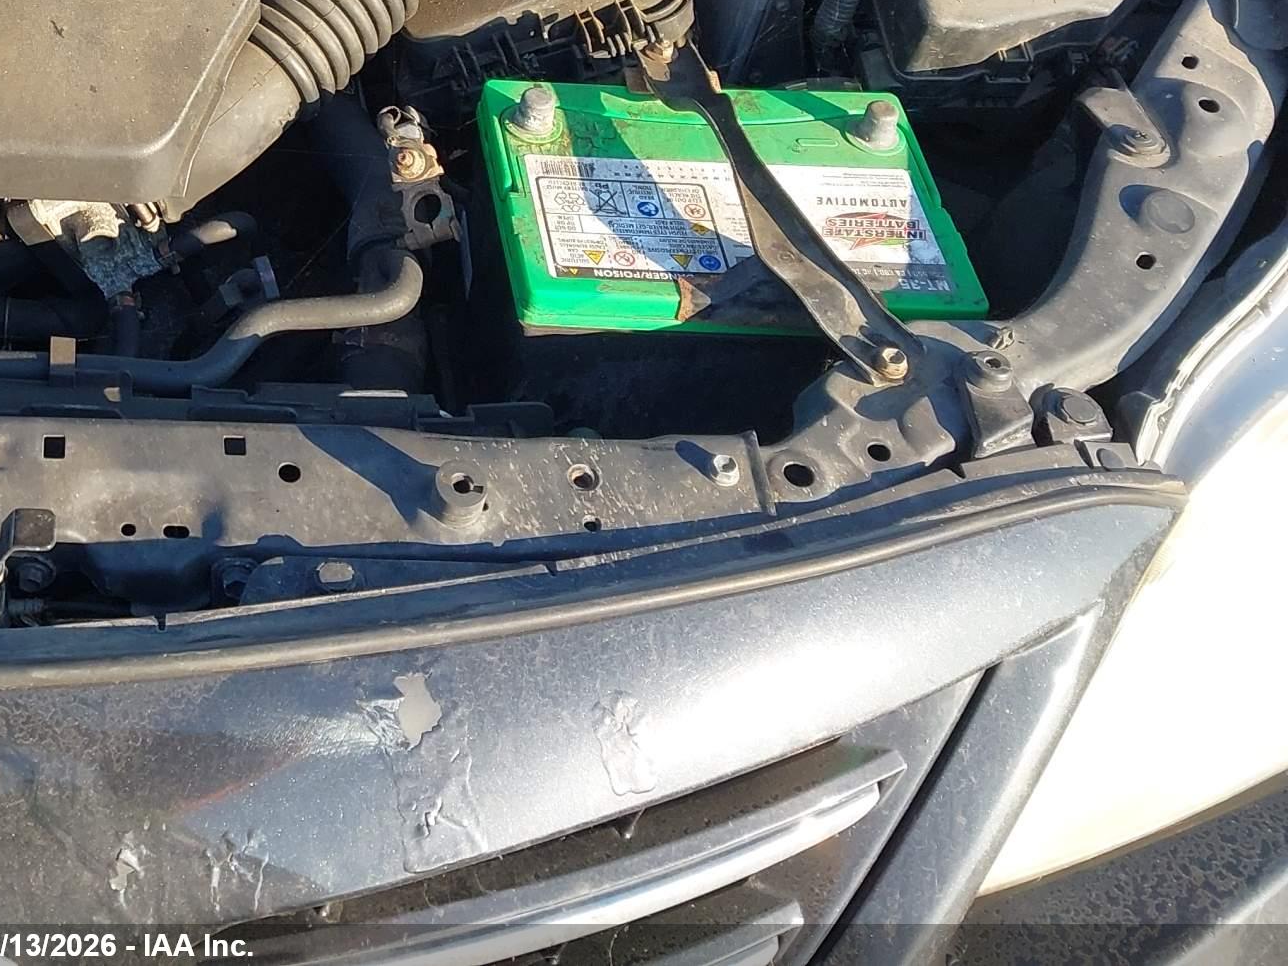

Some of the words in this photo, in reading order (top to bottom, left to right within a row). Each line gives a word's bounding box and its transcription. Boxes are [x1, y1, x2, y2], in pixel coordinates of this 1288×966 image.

[816, 197, 907, 208] AUTOMOTIVE
[824, 218, 918, 229] BATTERIES
[823, 228, 925, 240] INTERSTATE
[898, 278, 951, 291] MT-35
